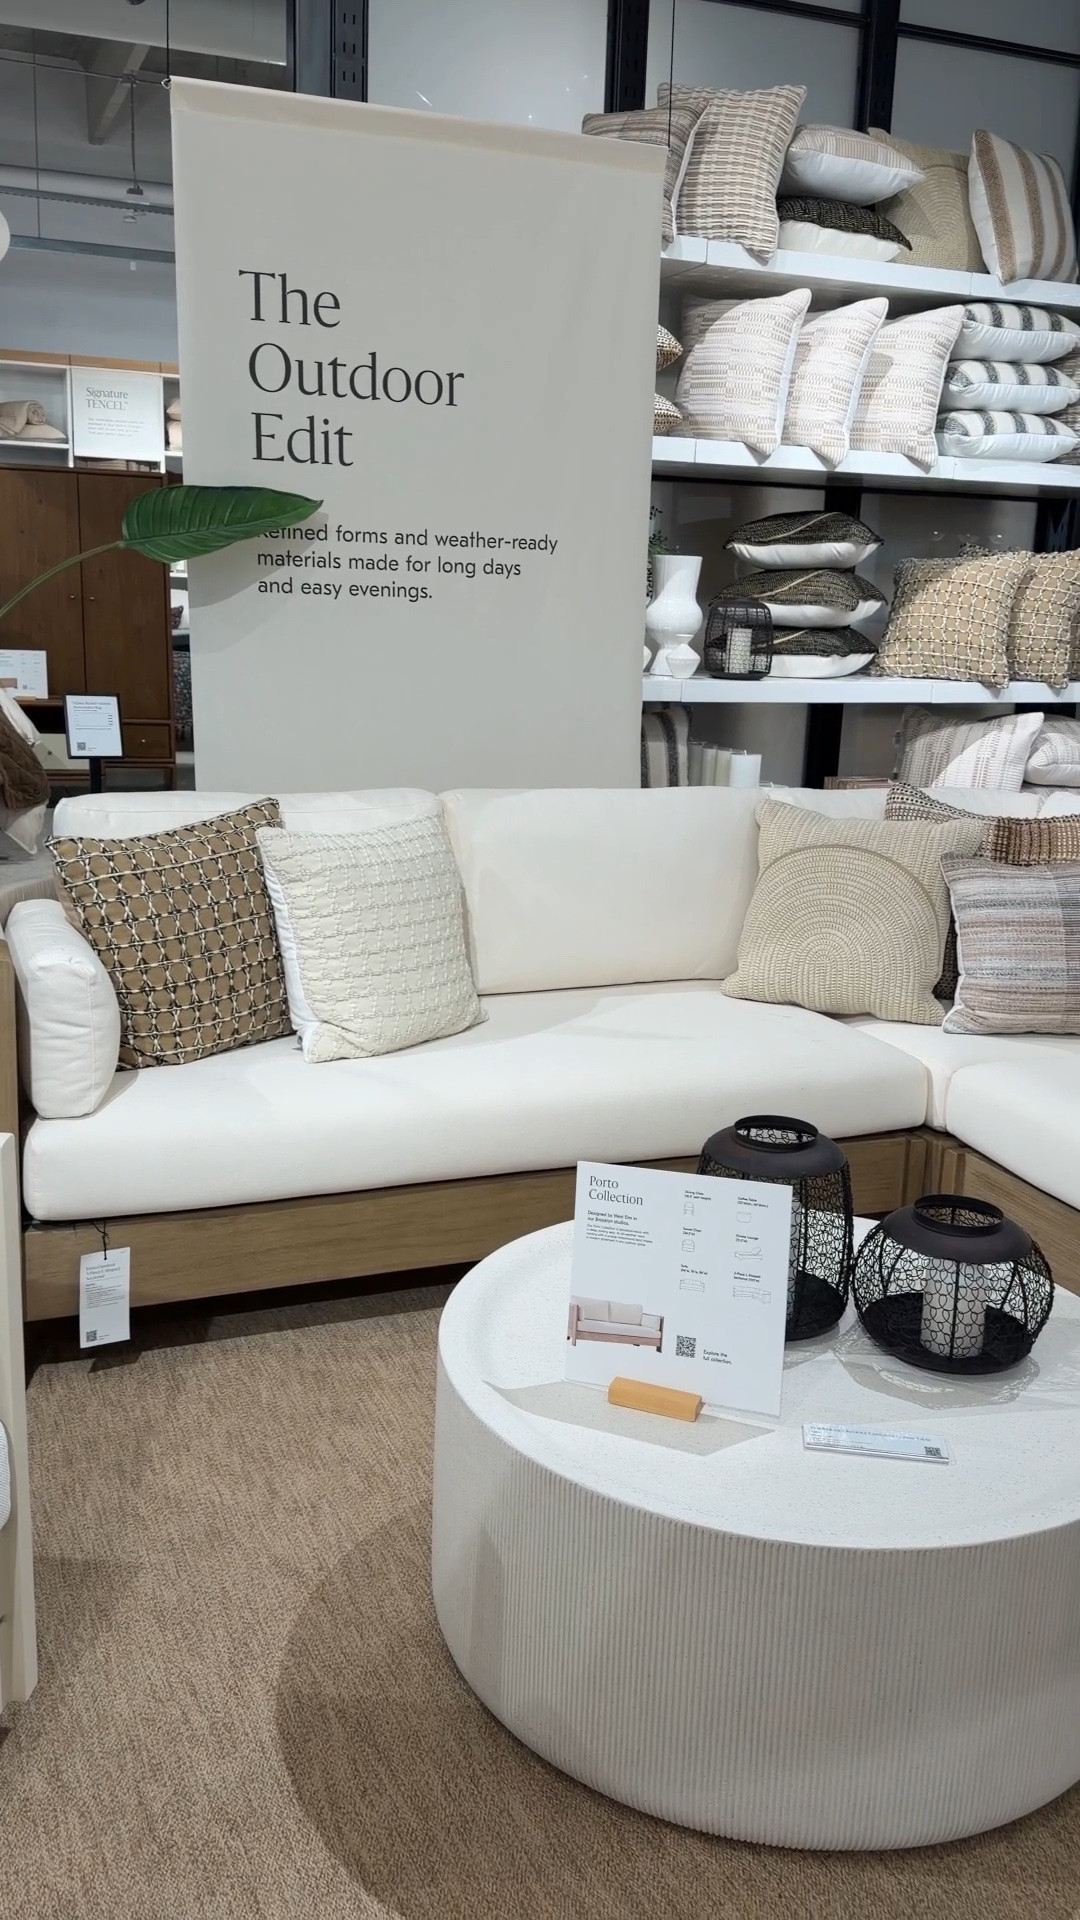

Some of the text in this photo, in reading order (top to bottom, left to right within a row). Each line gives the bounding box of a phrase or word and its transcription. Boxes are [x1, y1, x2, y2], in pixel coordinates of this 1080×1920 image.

[239, 269, 341, 328] The
[249, 342, 465, 407] Outdoor
[86, 386, 128, 399] Signature
[251, 411, 354, 467] Edit
[257, 523, 558, 555] efined forms and weather-ready
[257, 551, 522, 579] materials made for long days
[257, 576, 433, 603] and easy evenings.
[589, 1175, 619, 1189] Porto
[588, 1188, 643, 1206] Collection
